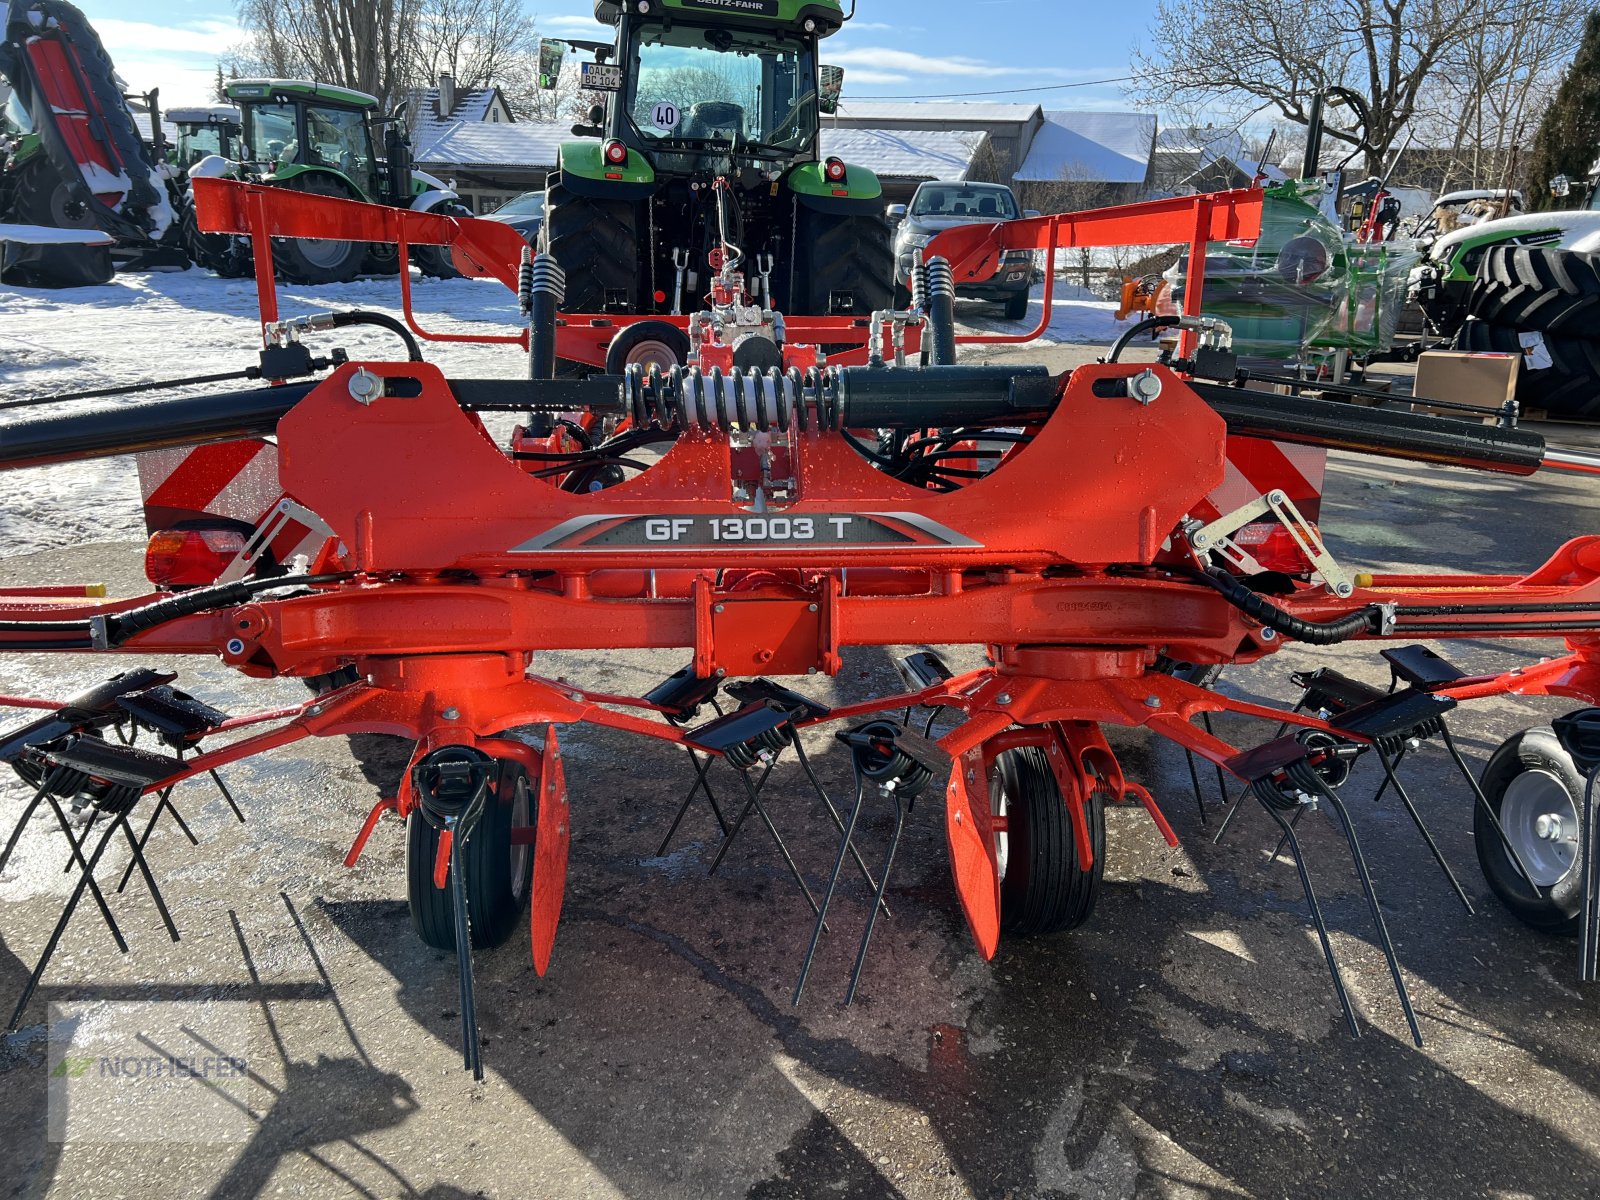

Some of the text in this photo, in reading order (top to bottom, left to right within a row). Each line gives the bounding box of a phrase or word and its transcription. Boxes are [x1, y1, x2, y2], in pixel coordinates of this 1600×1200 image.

[589, 66, 606, 76] OAL
[585, 75, 616, 87] BC 104
[656, 106, 674, 125] 40
[645, 517, 852, 541] GF 13003 T
